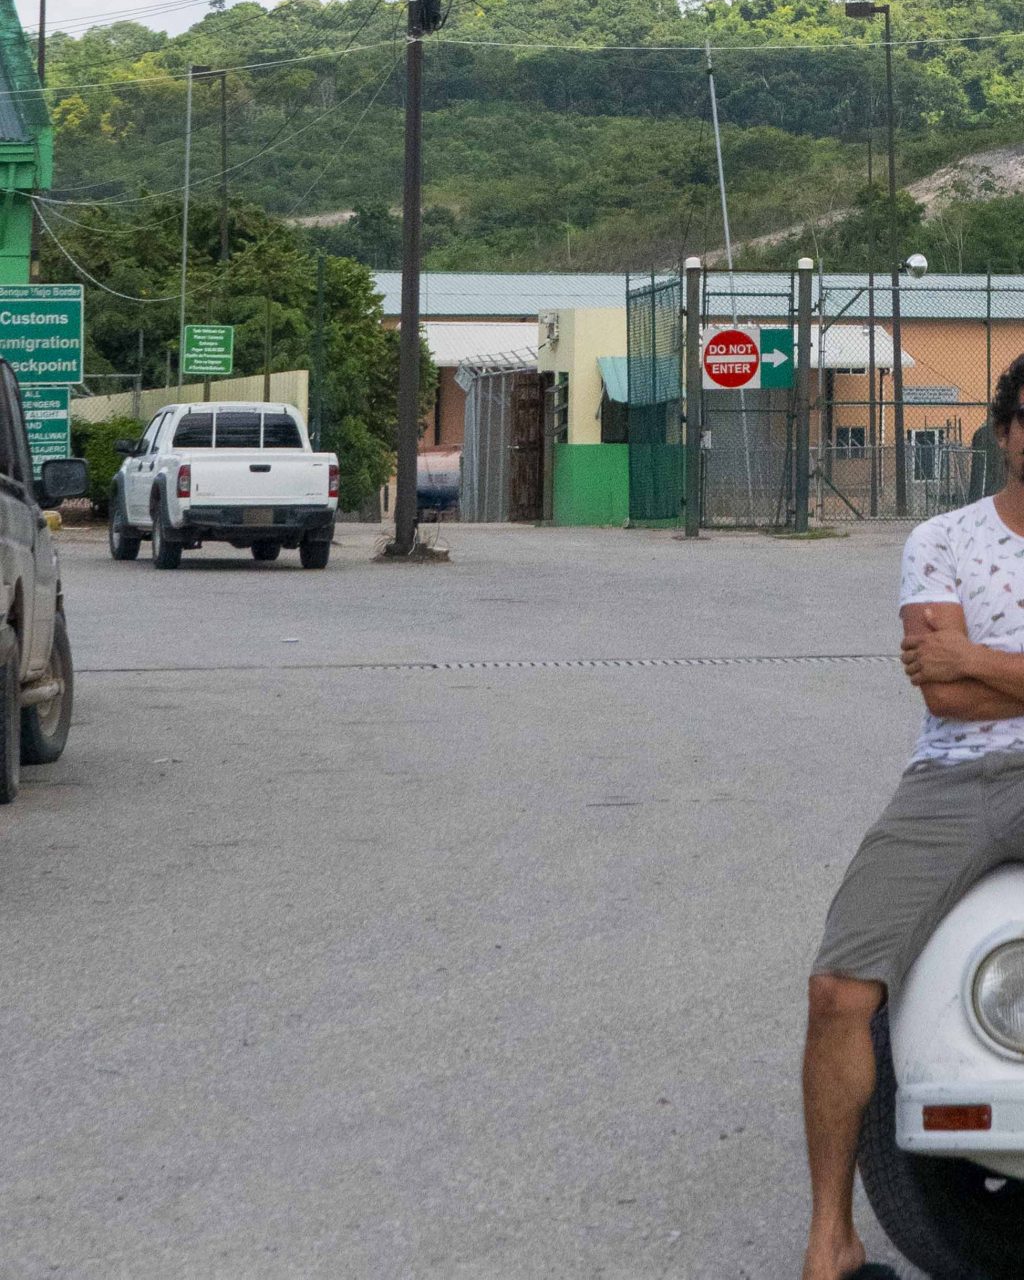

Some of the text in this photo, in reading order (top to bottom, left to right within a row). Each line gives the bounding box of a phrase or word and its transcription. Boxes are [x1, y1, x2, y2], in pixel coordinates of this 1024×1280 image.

[53, 287, 81, 297] Border
[0, 310, 69, 325] Customs
[0, 335, 80, 352] migration
[708, 343, 753, 355] DO NOT
[10, 358, 78, 375] eckpoint
[711, 363, 751, 374] ENTER
[22, 400, 61, 409] SENGERS
